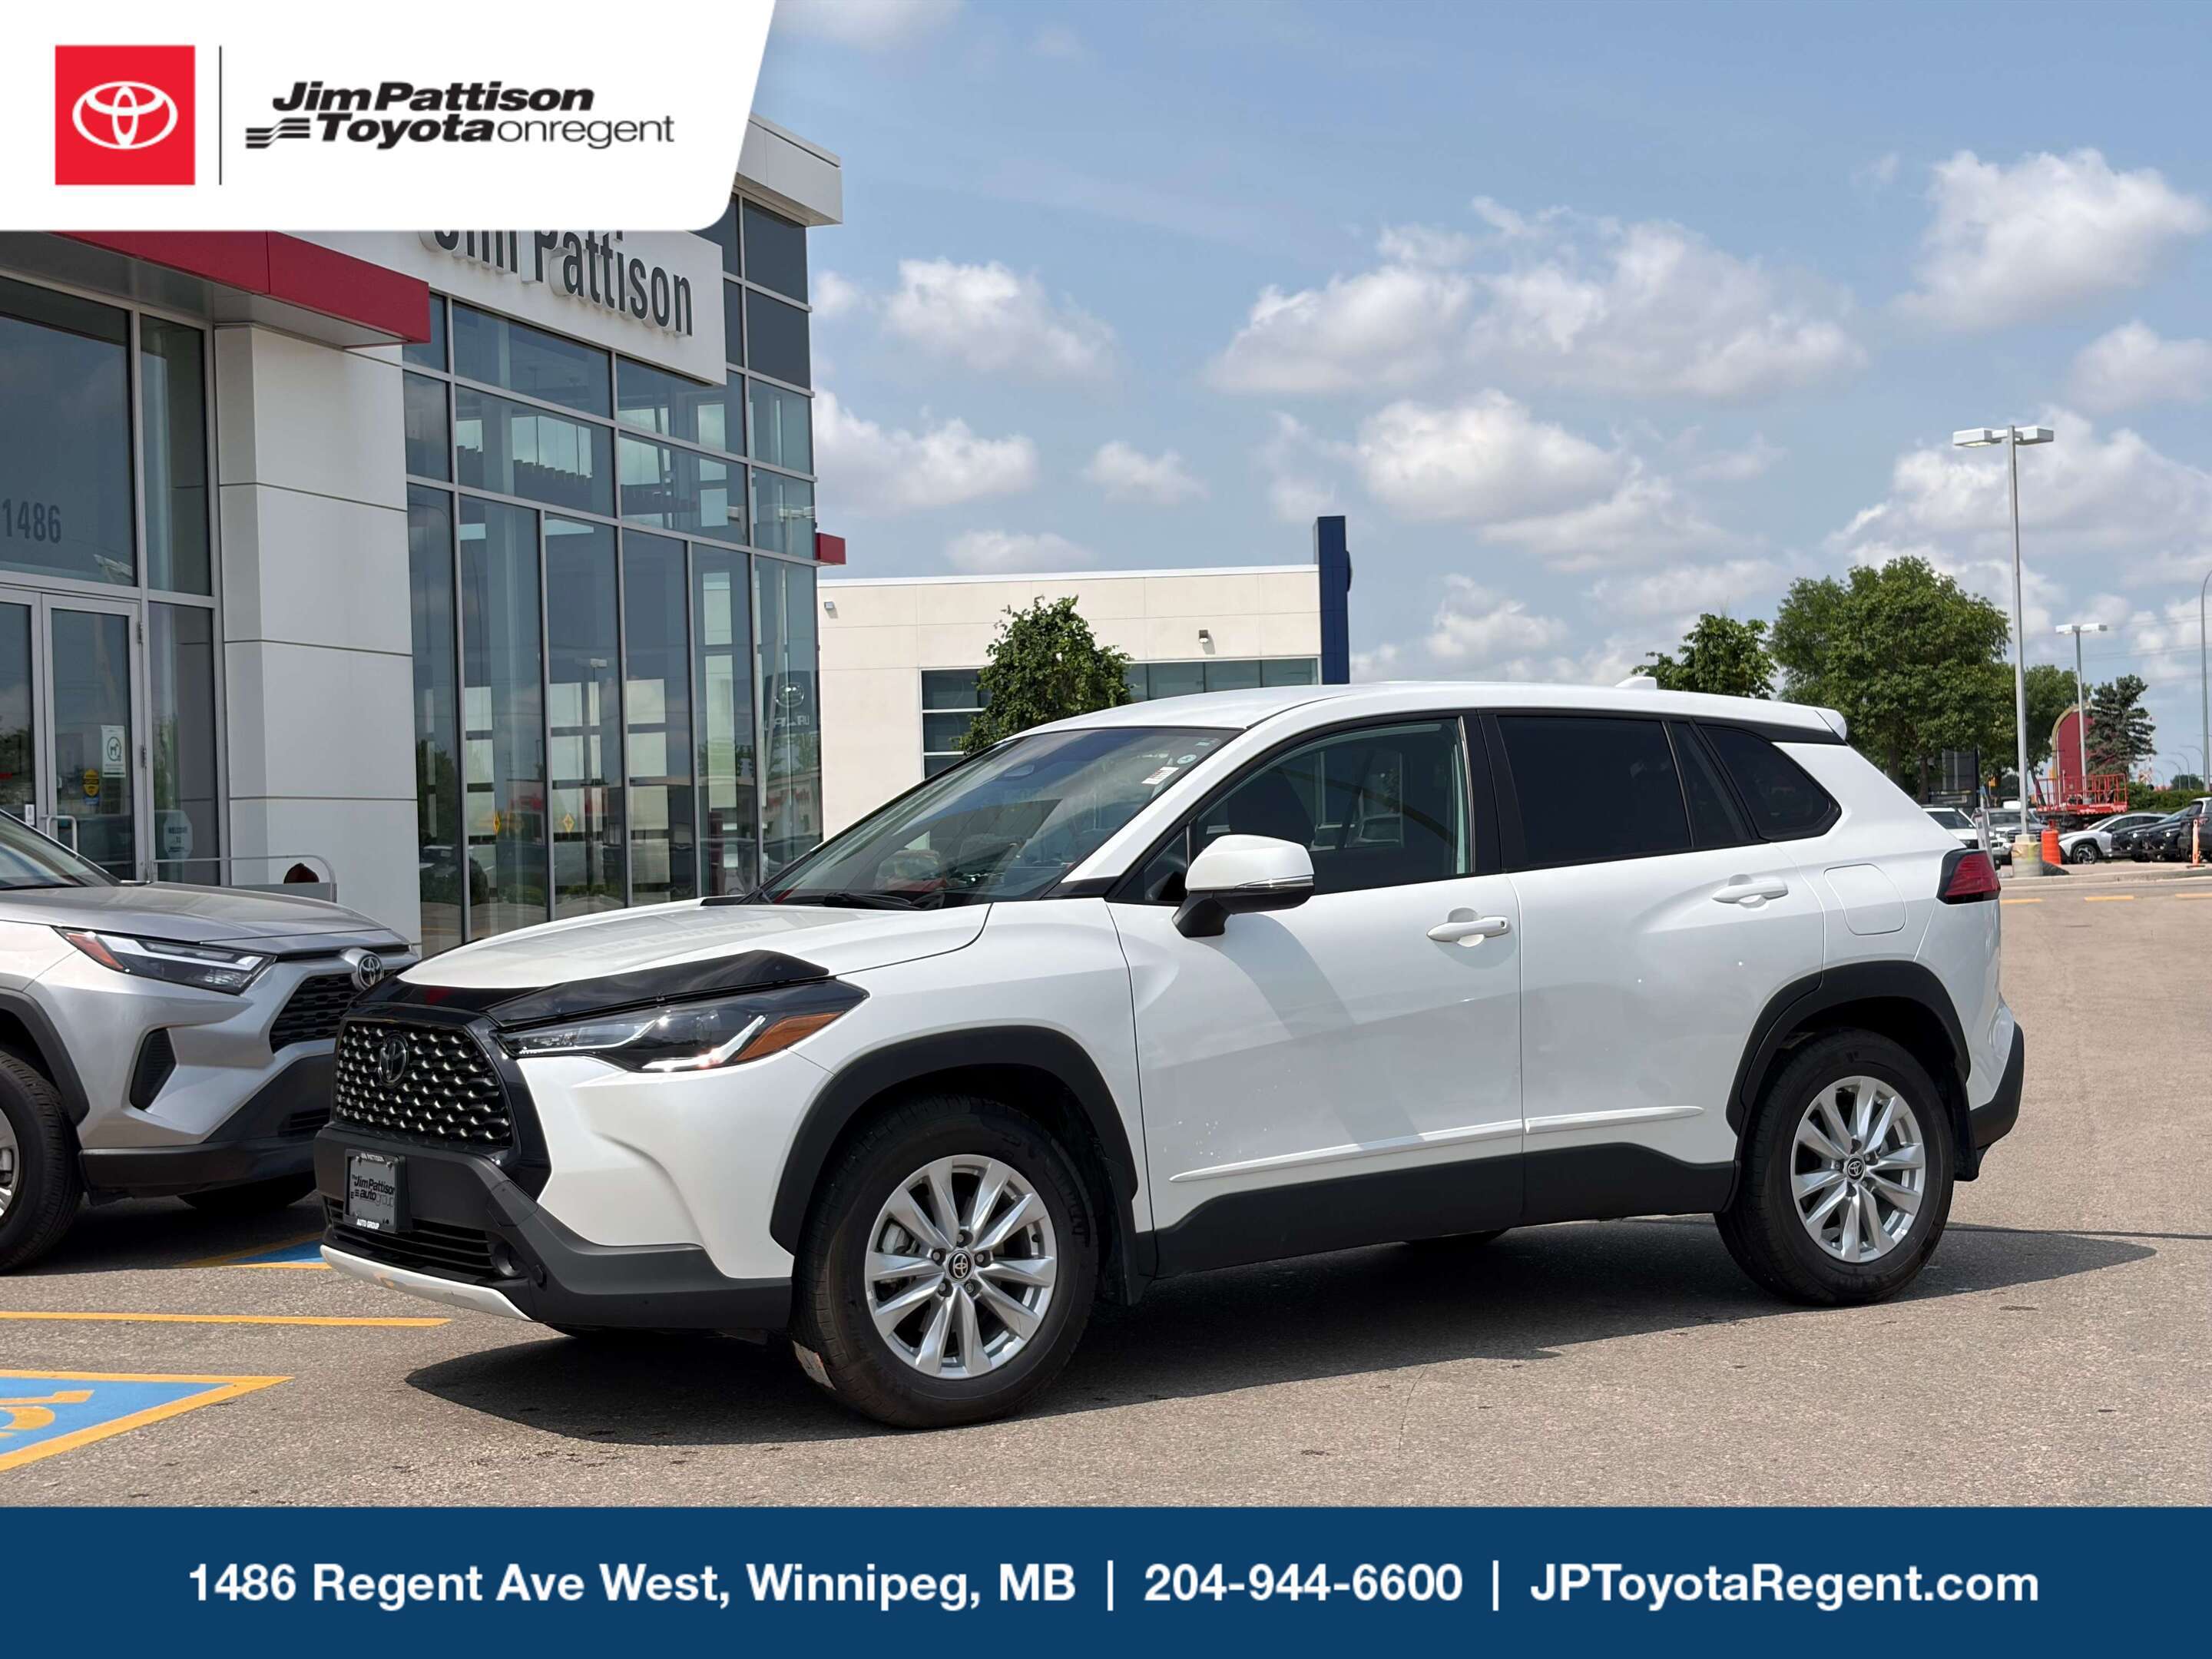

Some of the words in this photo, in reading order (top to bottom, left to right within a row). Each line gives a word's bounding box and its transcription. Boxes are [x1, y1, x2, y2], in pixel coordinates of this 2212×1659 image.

[534, 229, 693, 336] Pattison
[2, 498, 61, 543] 1486
[354, 1175, 369, 1189] Jim
[368, 1178, 396, 1195] Pattiso
